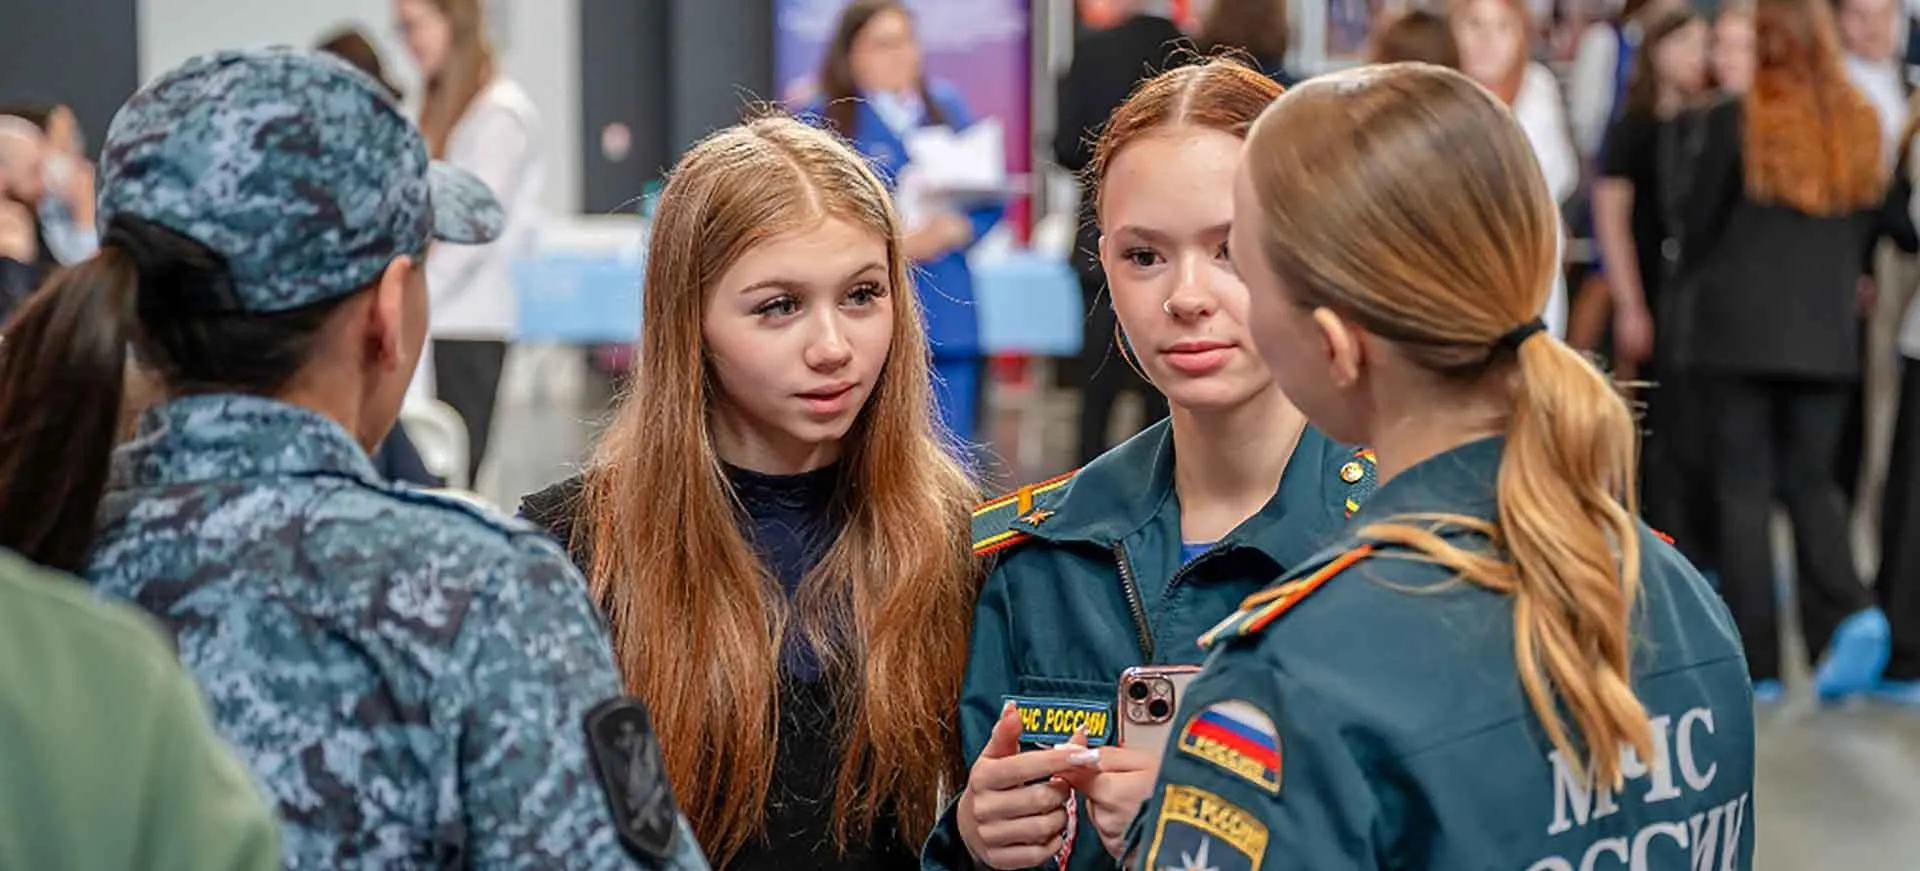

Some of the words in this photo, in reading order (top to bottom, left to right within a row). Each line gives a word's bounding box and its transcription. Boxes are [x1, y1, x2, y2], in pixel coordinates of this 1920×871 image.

[1017, 708, 1041, 732] ЧС
[1044, 708, 1107, 737] РОССИИ
[1525, 791, 1748, 871] СИИ
